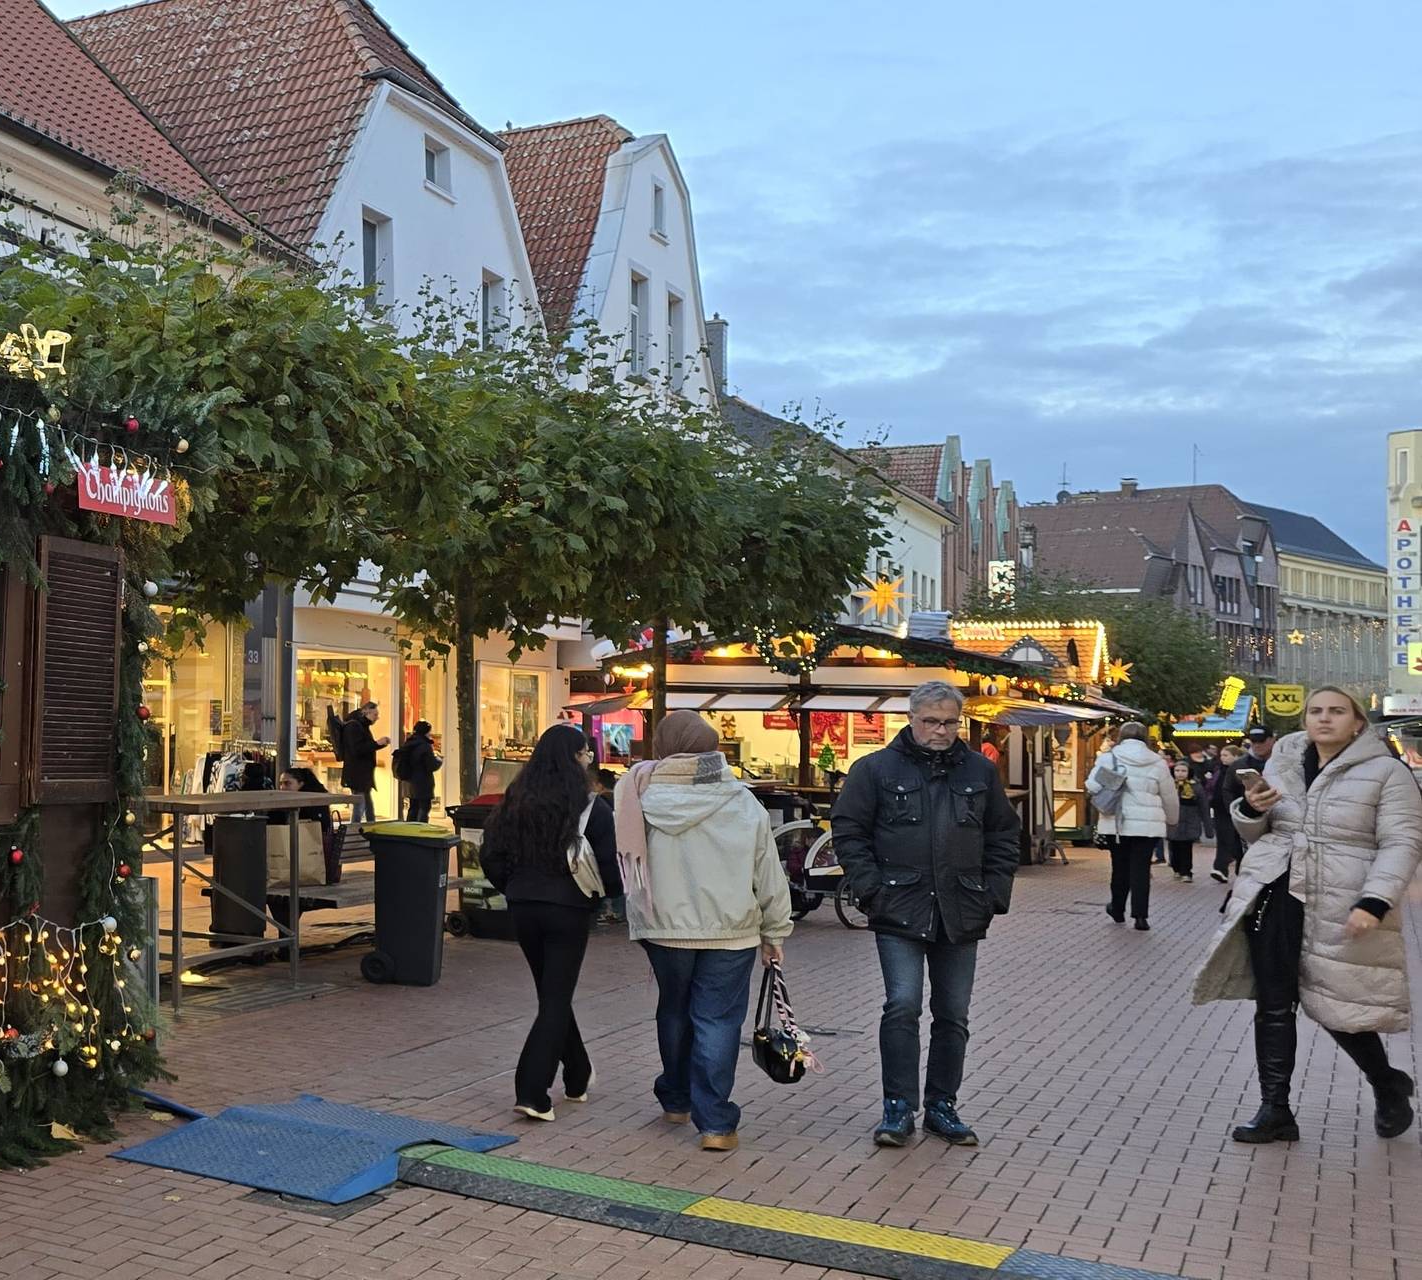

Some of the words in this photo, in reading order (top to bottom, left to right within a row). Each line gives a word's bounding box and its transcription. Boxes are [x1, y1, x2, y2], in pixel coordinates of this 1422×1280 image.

[1396, 519, 1413, 665] APOTHEKE
[248, 650, 259, 664] 33
[1270, 693, 1300, 704] XXL
